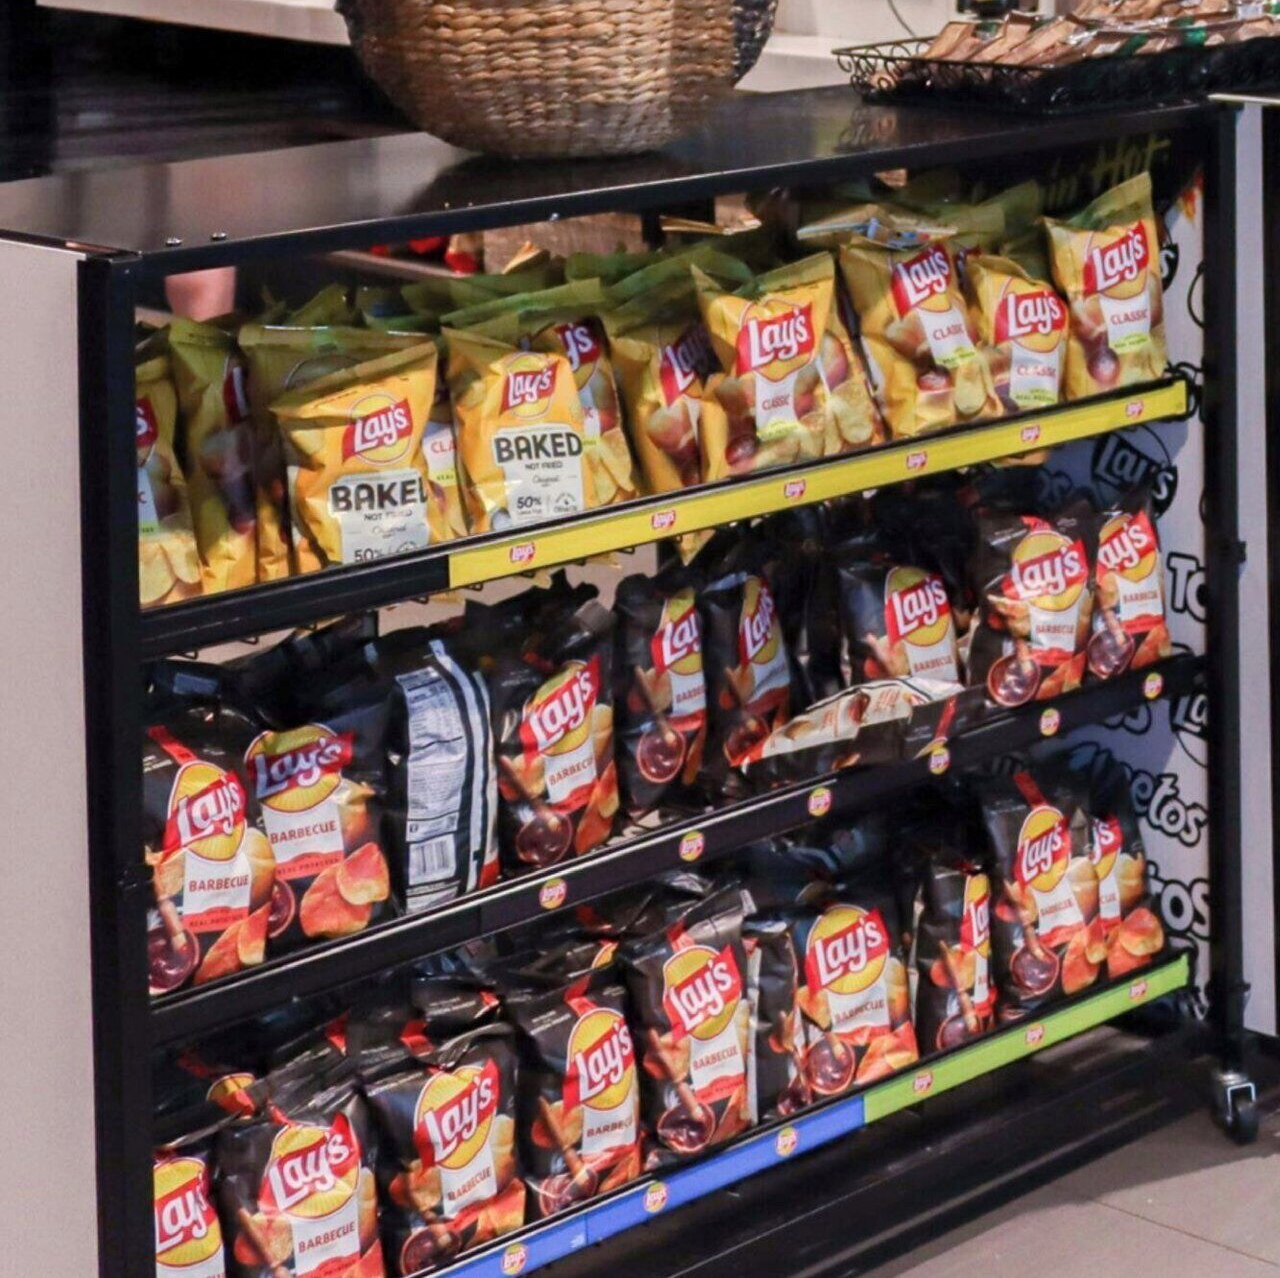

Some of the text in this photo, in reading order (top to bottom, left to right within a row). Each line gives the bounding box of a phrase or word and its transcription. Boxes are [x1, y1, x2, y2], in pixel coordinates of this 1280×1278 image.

[898, 243, 949, 305] Lay's
[1093, 232, 1145, 291] Lay's
[1008, 291, 1062, 337] Lay's
[1111, 309, 1148, 325] CLASSIC
[750, 309, 809, 370] Lay's
[508, 367, 553, 406] Lay's
[1017, 365, 1056, 378] CLASSIC
[762, 394, 790, 410] CLASSIC
[354, 405, 409, 453] Lay's
[494, 432, 583, 463] BAKED
[525, 462, 542, 470] NOT
[364, 512, 383, 521] NOT
[517, 495, 542, 510] 50%
[1099, 522, 1148, 569] ay's
[1012, 546, 1081, 598] Lay's
[892, 580, 947, 635] Lay's
[1123, 590, 1157, 603] BARBECUE
[1036, 623, 1074, 634] BARBECUE
[914, 655, 954, 671] BARBECUE
[529, 670, 592, 751] Lay's
[255, 738, 342, 798] Lay's
[178, 774, 239, 845] Lay's
[270, 822, 336, 844] BARBECUE
[1021, 825, 1063, 884] Lay's
[189, 875, 248, 892] BARBECUE
[815, 918, 881, 986] Lay's
[670, 958, 733, 1030] Lay's
[835, 1000, 884, 1020] BARBECUE
[574, 1023, 631, 1100] Lay's
[693, 1046, 738, 1069] BARBECUE
[424, 1075, 493, 1163] Lay's
[269, 1133, 349, 1213] Lay's
[448, 1167, 492, 1201] BARBECUE
[298, 1222, 355, 1253] BARBECUE
